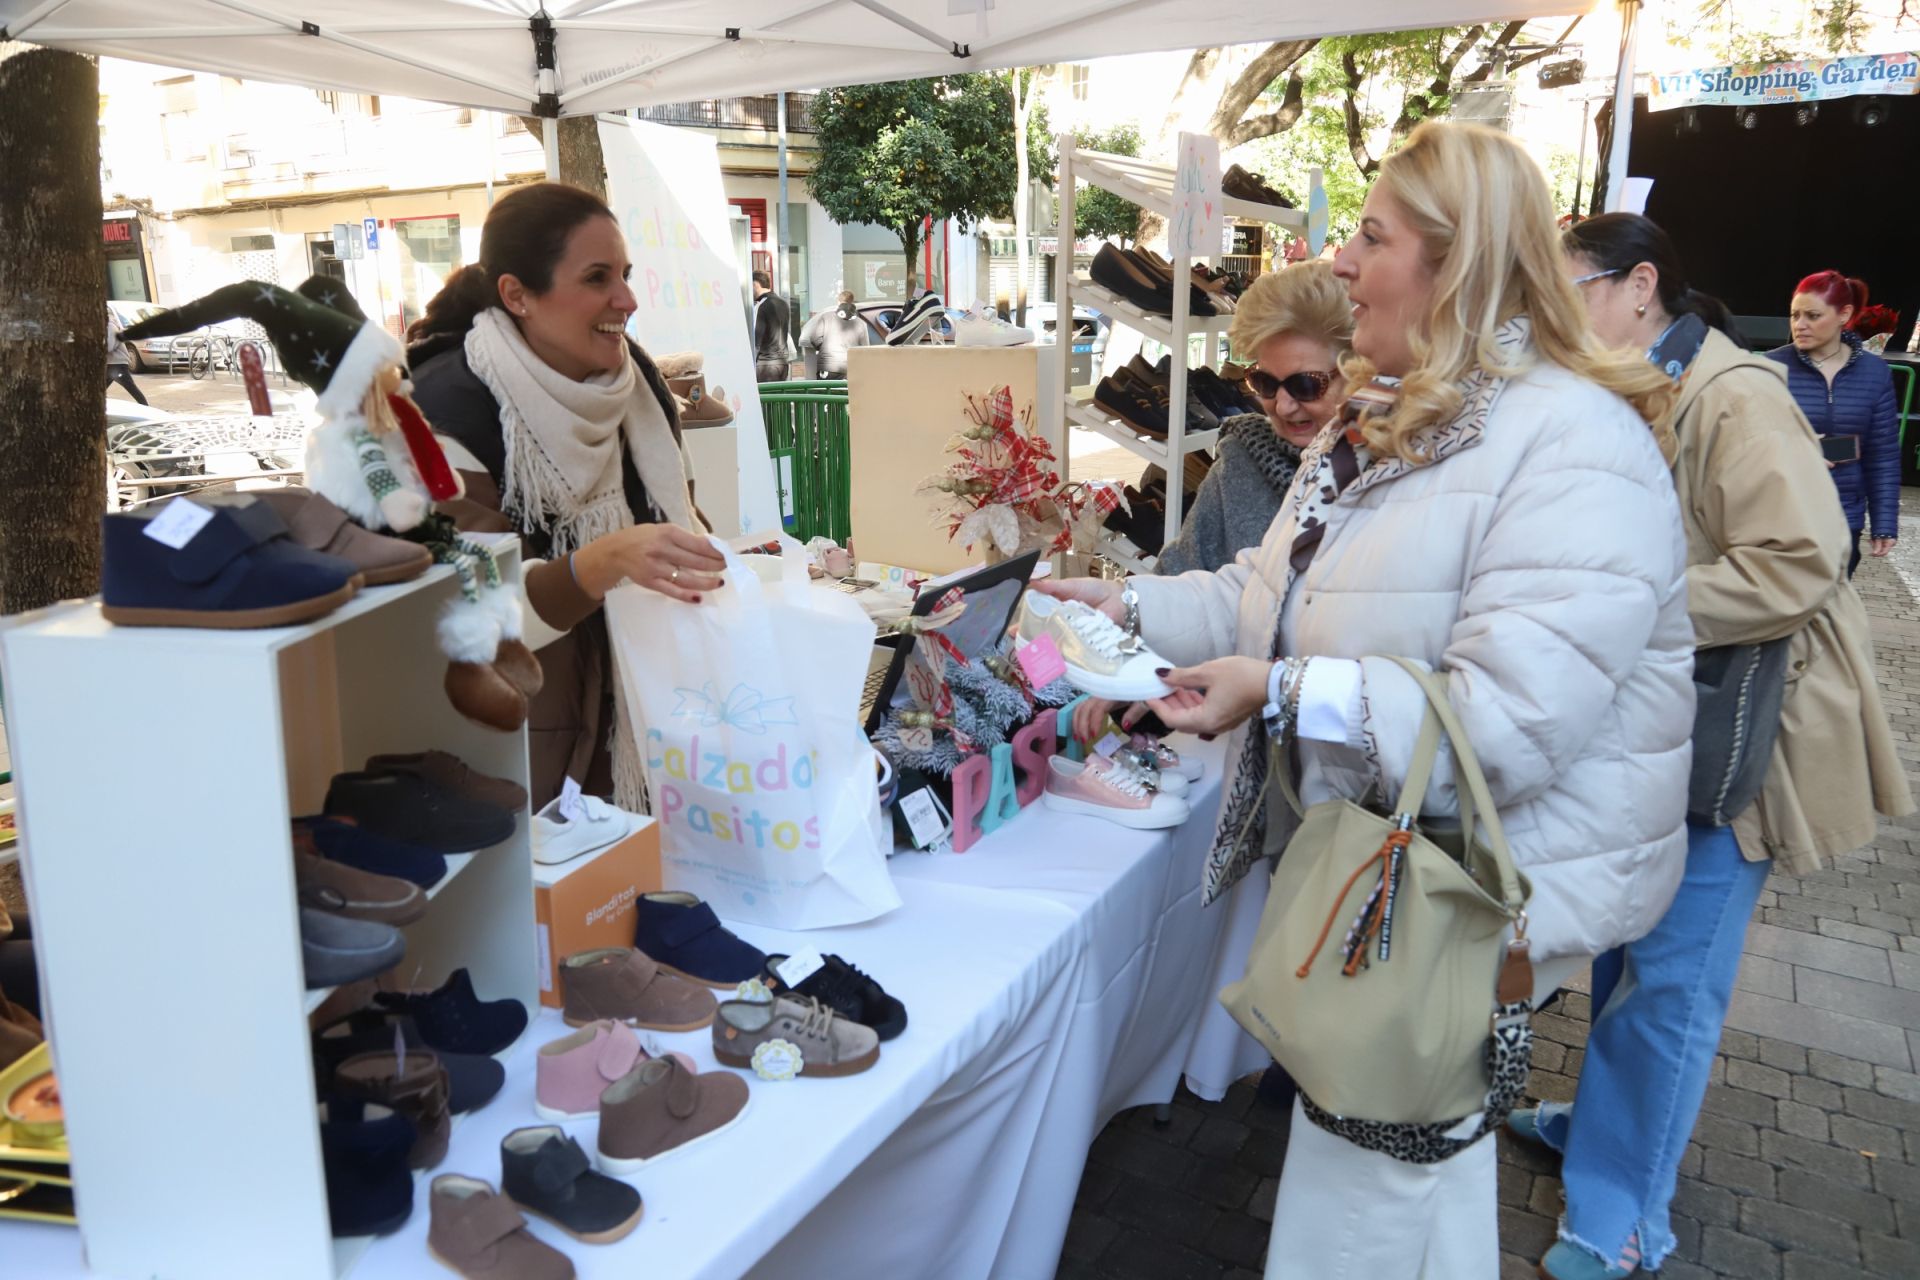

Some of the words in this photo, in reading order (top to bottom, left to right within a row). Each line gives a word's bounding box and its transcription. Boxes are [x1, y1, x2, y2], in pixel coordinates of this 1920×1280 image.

[1699, 67, 1815, 97] Shopping
[1820, 59, 1918, 86] Garden
[365, 221, 375, 239] P
[645, 267, 724, 309] Pasitos
[661, 784, 821, 851] Pasitos
